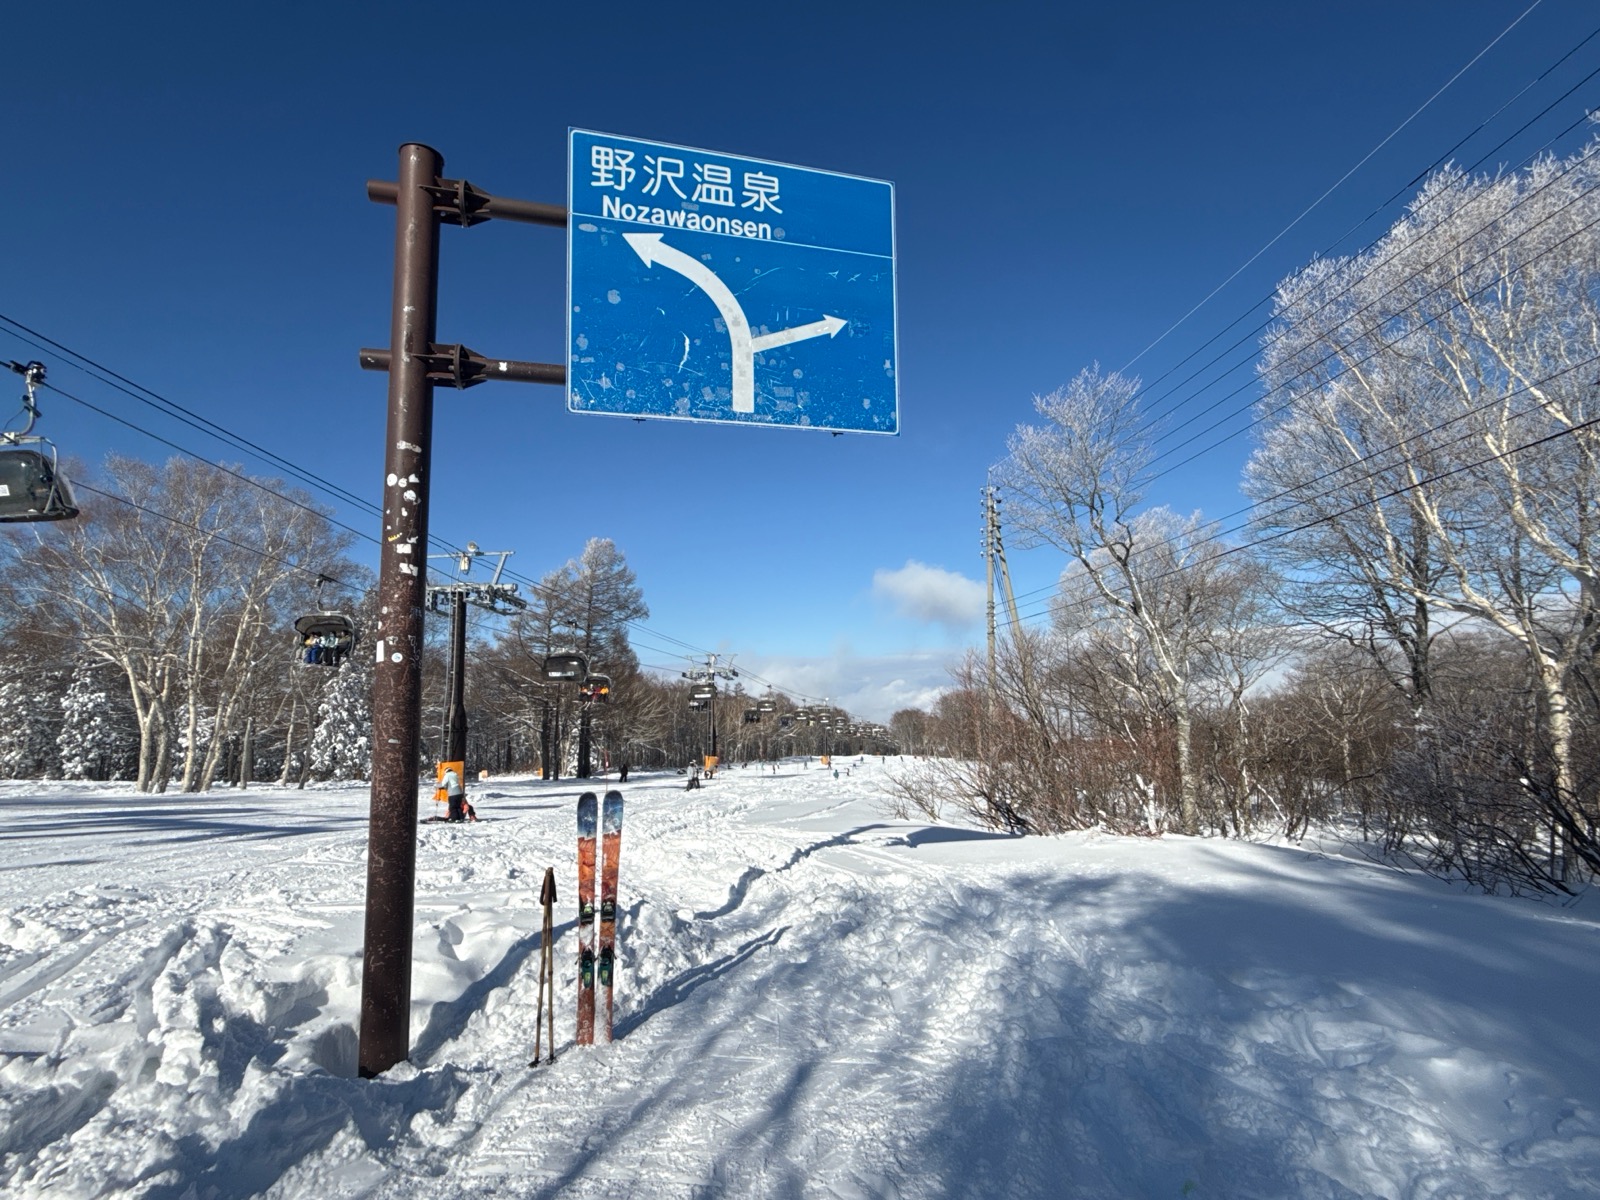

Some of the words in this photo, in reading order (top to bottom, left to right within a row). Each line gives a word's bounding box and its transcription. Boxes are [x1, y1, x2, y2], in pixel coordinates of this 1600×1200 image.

[591, 145, 783, 214] 野沢温泉
[602, 194, 772, 240] Nozawaonsen
